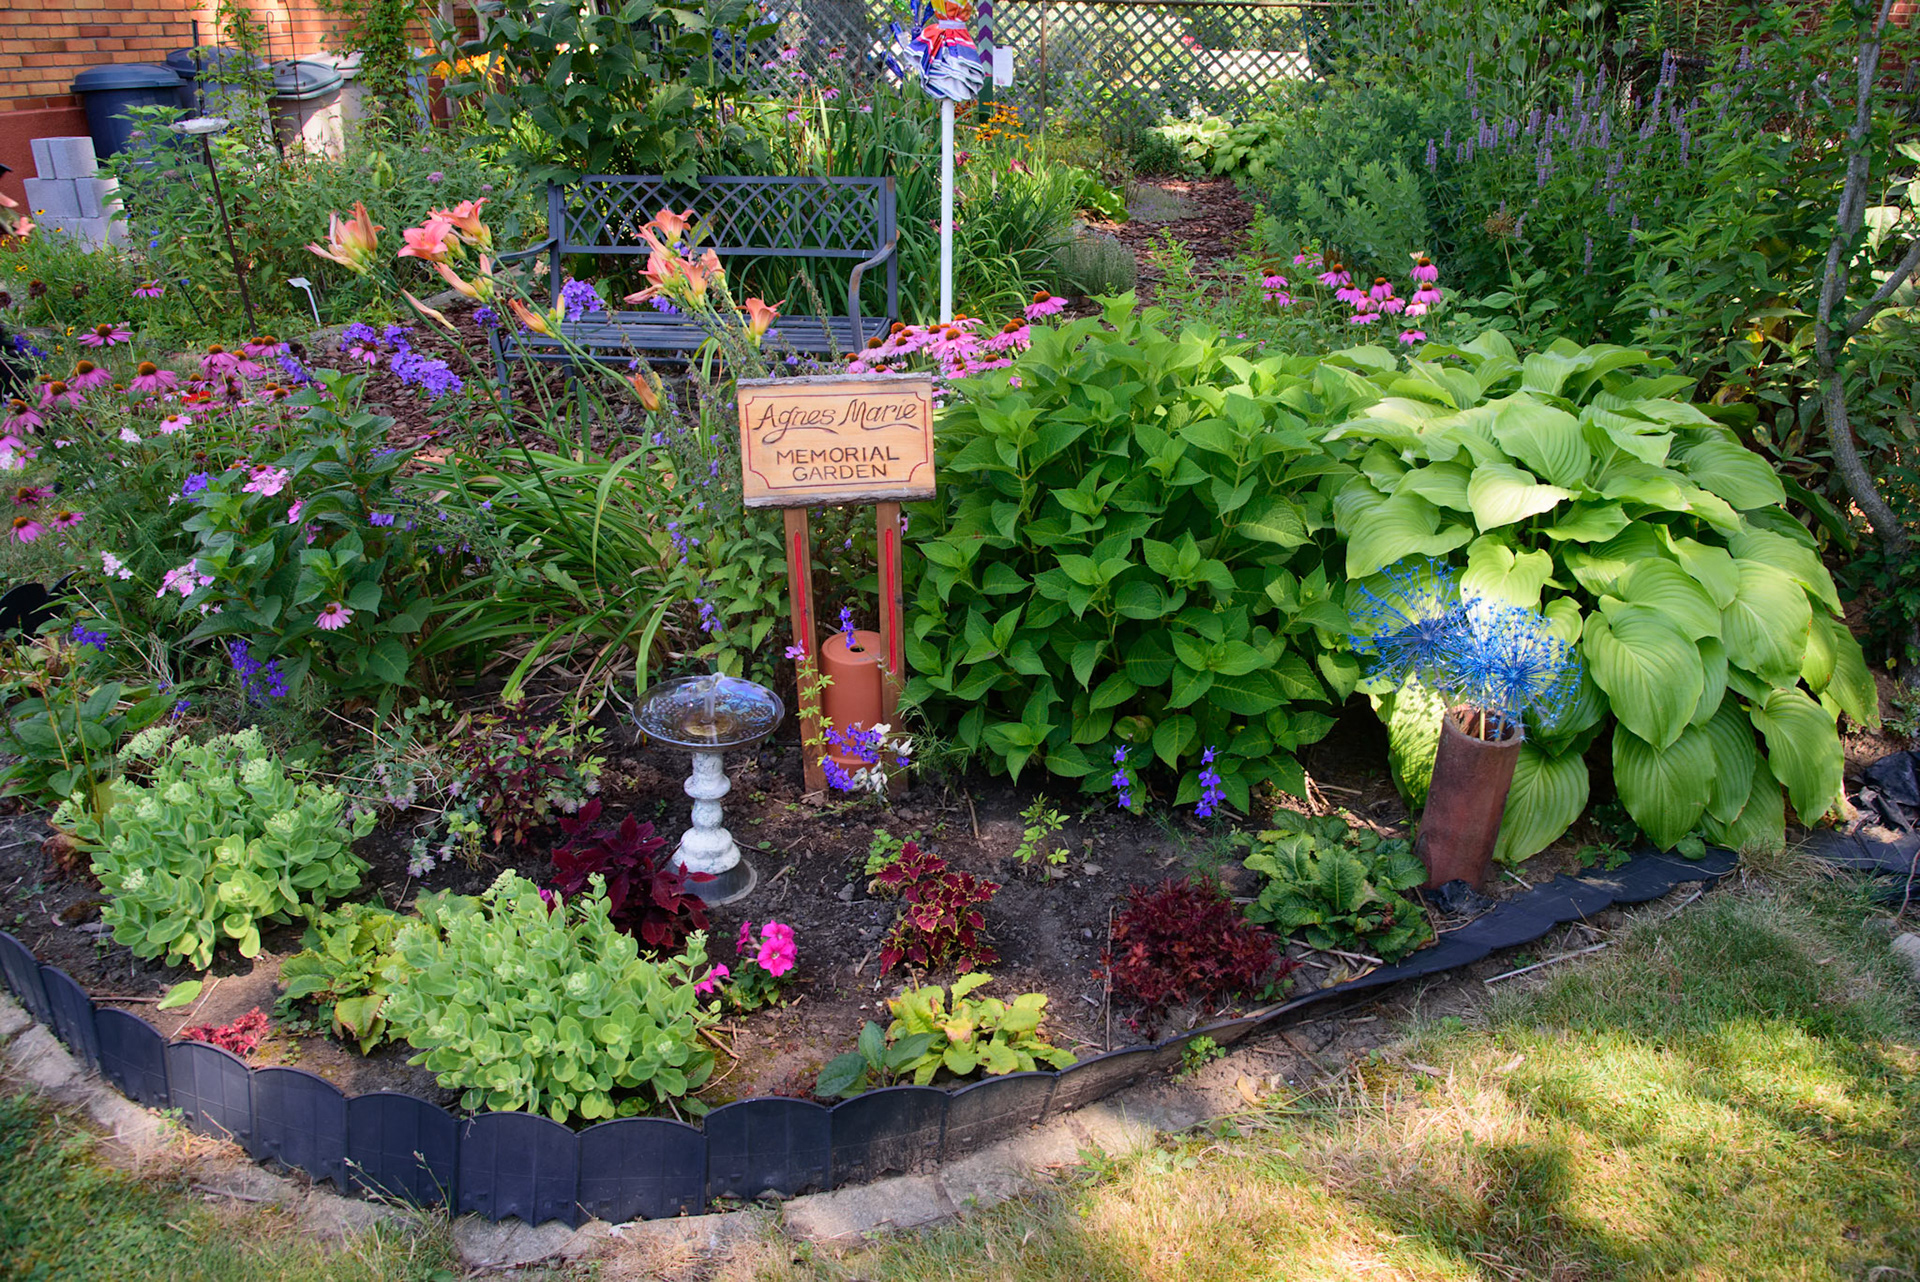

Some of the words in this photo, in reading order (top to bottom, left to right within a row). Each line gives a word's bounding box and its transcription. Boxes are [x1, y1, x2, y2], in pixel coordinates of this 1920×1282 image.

[752, 403, 839, 445] Agnes
[838, 398, 920, 431] Marie
[776, 446, 900, 465] MEMORIAL
[792, 464, 888, 482] GARDEN
